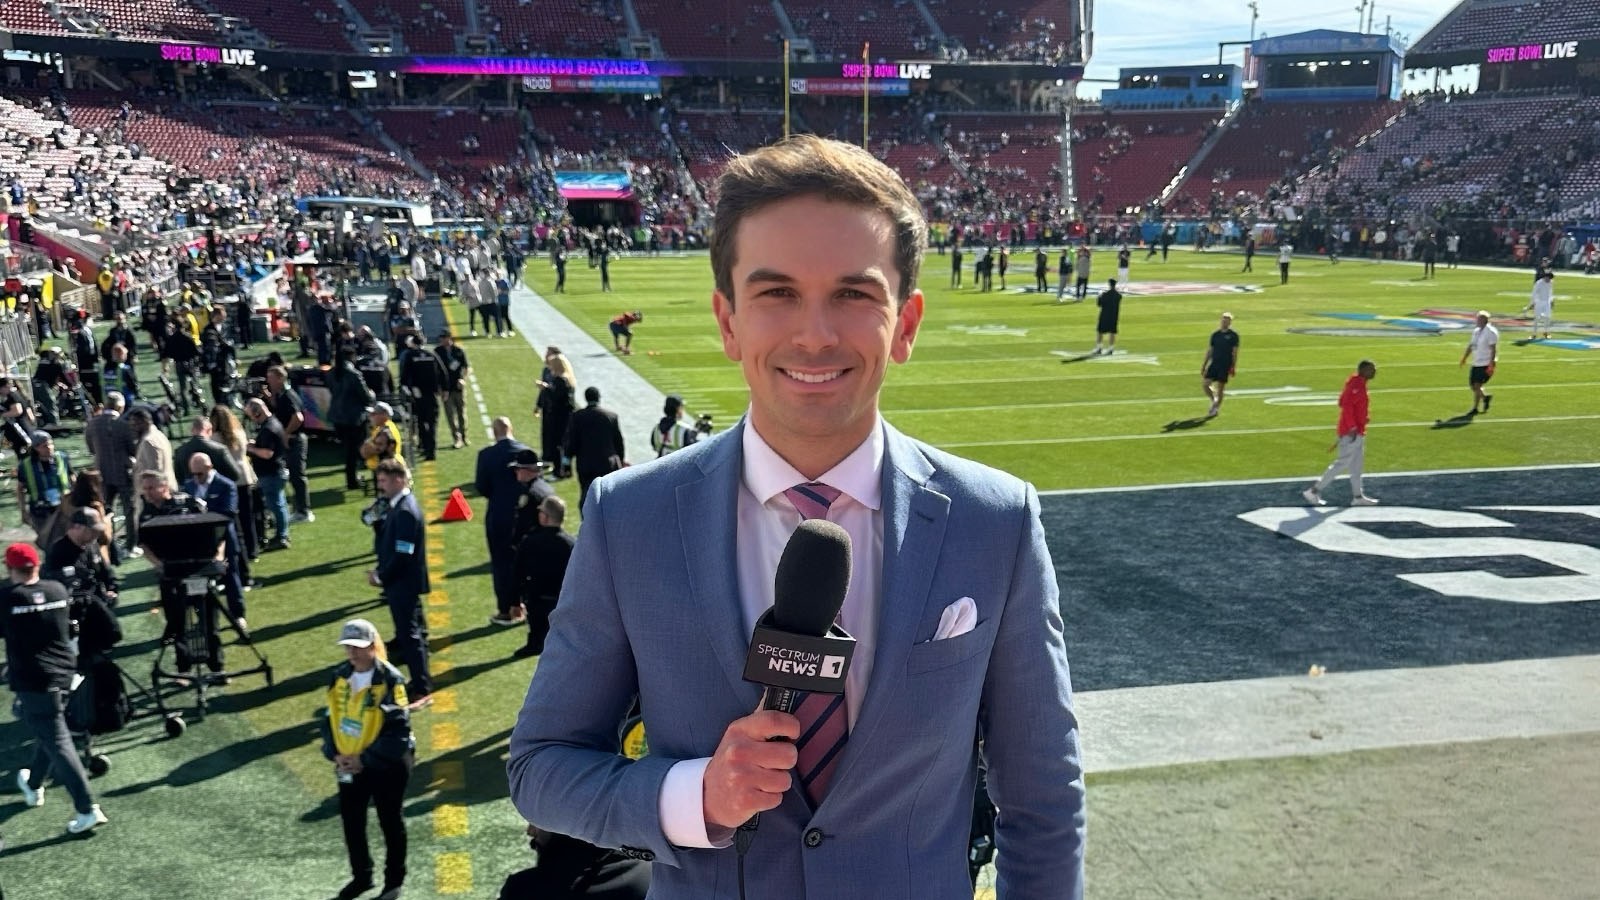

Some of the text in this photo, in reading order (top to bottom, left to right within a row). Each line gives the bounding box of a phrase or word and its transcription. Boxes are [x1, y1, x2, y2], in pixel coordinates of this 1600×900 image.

[161, 44, 256, 66] SUPER BOWL LIVE
[1487, 41, 1578, 62] SUPER BOWL LIVE
[480, 59, 650, 75] SAN FRANCISCO BAY AREA
[842, 63, 931, 79] SUPER BOWL LIVE
[757, 643, 821, 664] SPECTRUM
[768, 657, 817, 677] NEWS
